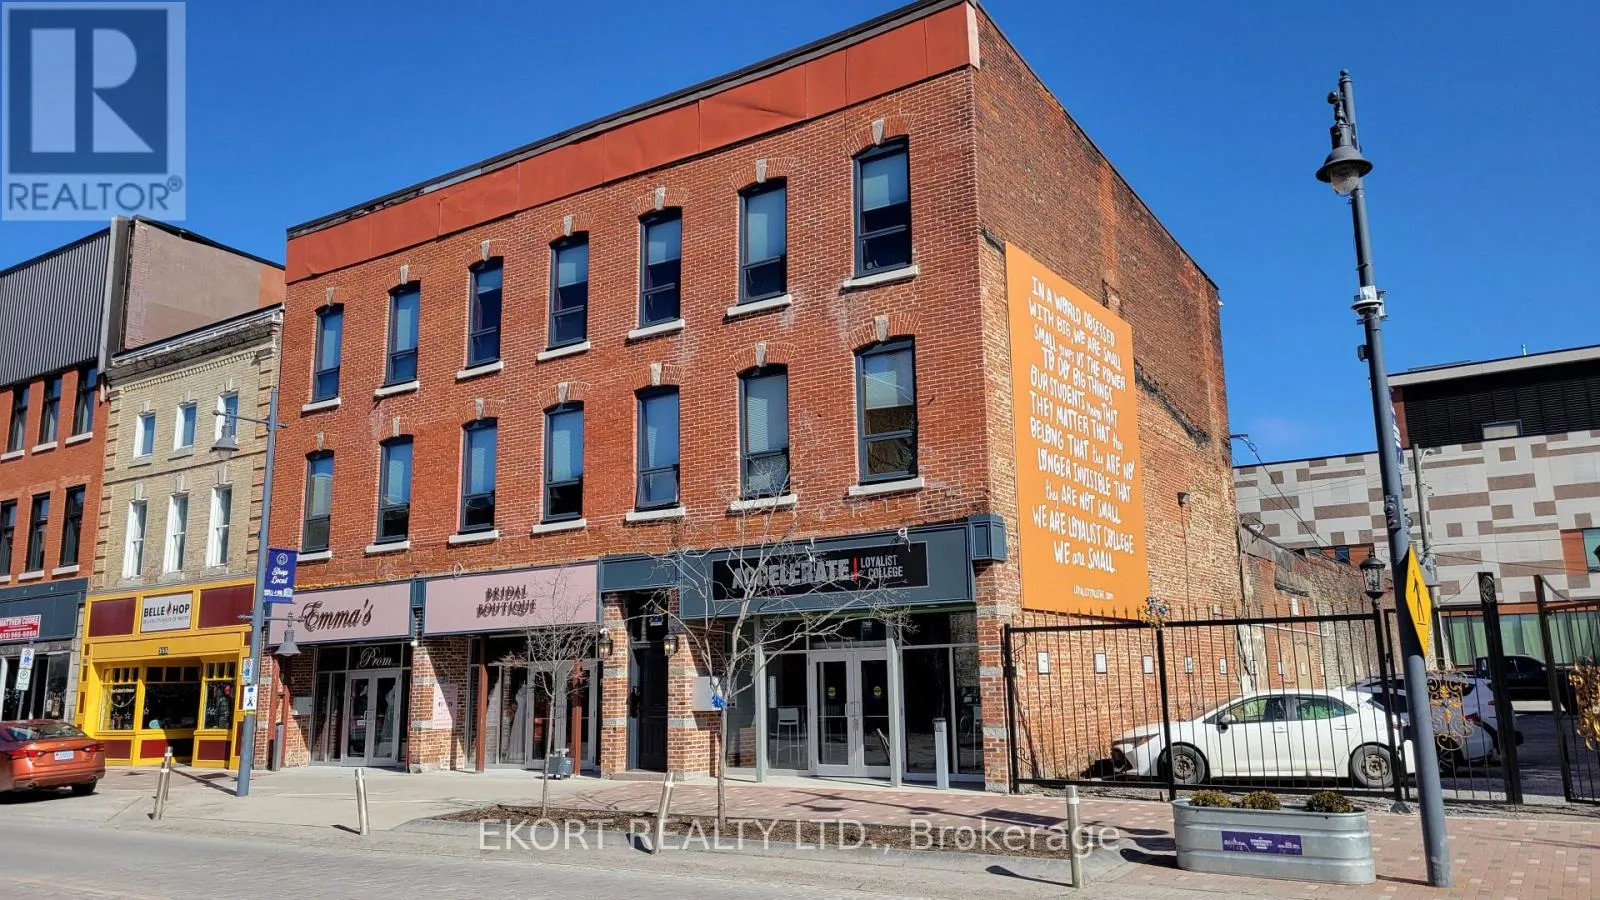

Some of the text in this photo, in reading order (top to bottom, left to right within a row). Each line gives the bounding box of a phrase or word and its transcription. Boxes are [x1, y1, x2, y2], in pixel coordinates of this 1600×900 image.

[1028, 297, 1054, 328] WITH
[1073, 326, 1086, 345] WE
[1087, 335, 1101, 357] ARE
[1031, 275, 1116, 347] IN A WORLD OBSESSED
[1034, 323, 1057, 352] SMALL
[1087, 355, 1100, 377] THE
[1102, 366, 1126, 392] POWER
[1041, 346, 1055, 371] TO
[1073, 367, 1087, 388] BIG
[1030, 364, 1048, 393] OUR
[1050, 377, 1086, 410] STUDENTS
[1101, 402, 1118, 430] THAT
[1029, 390, 1054, 422] THEY
[1056, 405, 1090, 438] MATTER
[1090, 419, 1110, 444] THAT
[1029, 416, 1064, 450] BELONG
[1066, 434, 1089, 461] THAT
[1106, 452, 1120, 475] ARE
[1123, 460, 1135, 480] NO
[1037, 447, 1131, 503] LONGER INVISIBLE THAT
[1060, 483, 1078, 507] ARE
[1079, 491, 1095, 515] NOT
[1032, 504, 1048, 528] WE
[1049, 509, 1066, 536] ARE
[1069, 515, 1101, 546] LOYALIST
[1053, 540, 1071, 565] WE
[271, 575, 289, 584] Local
[272, 566, 289, 577] Shop
[731, 559, 850, 589] ACCELERATE
[868, 566, 904, 579] COLLEGE
[476, 599, 537, 618] BOUTIQUE
[485, 584, 528, 602] BRIDAL
[143, 603, 190, 618] BELLE HOP
[301, 598, 374, 632] Emma's
[360, 646, 393, 668] Prom
